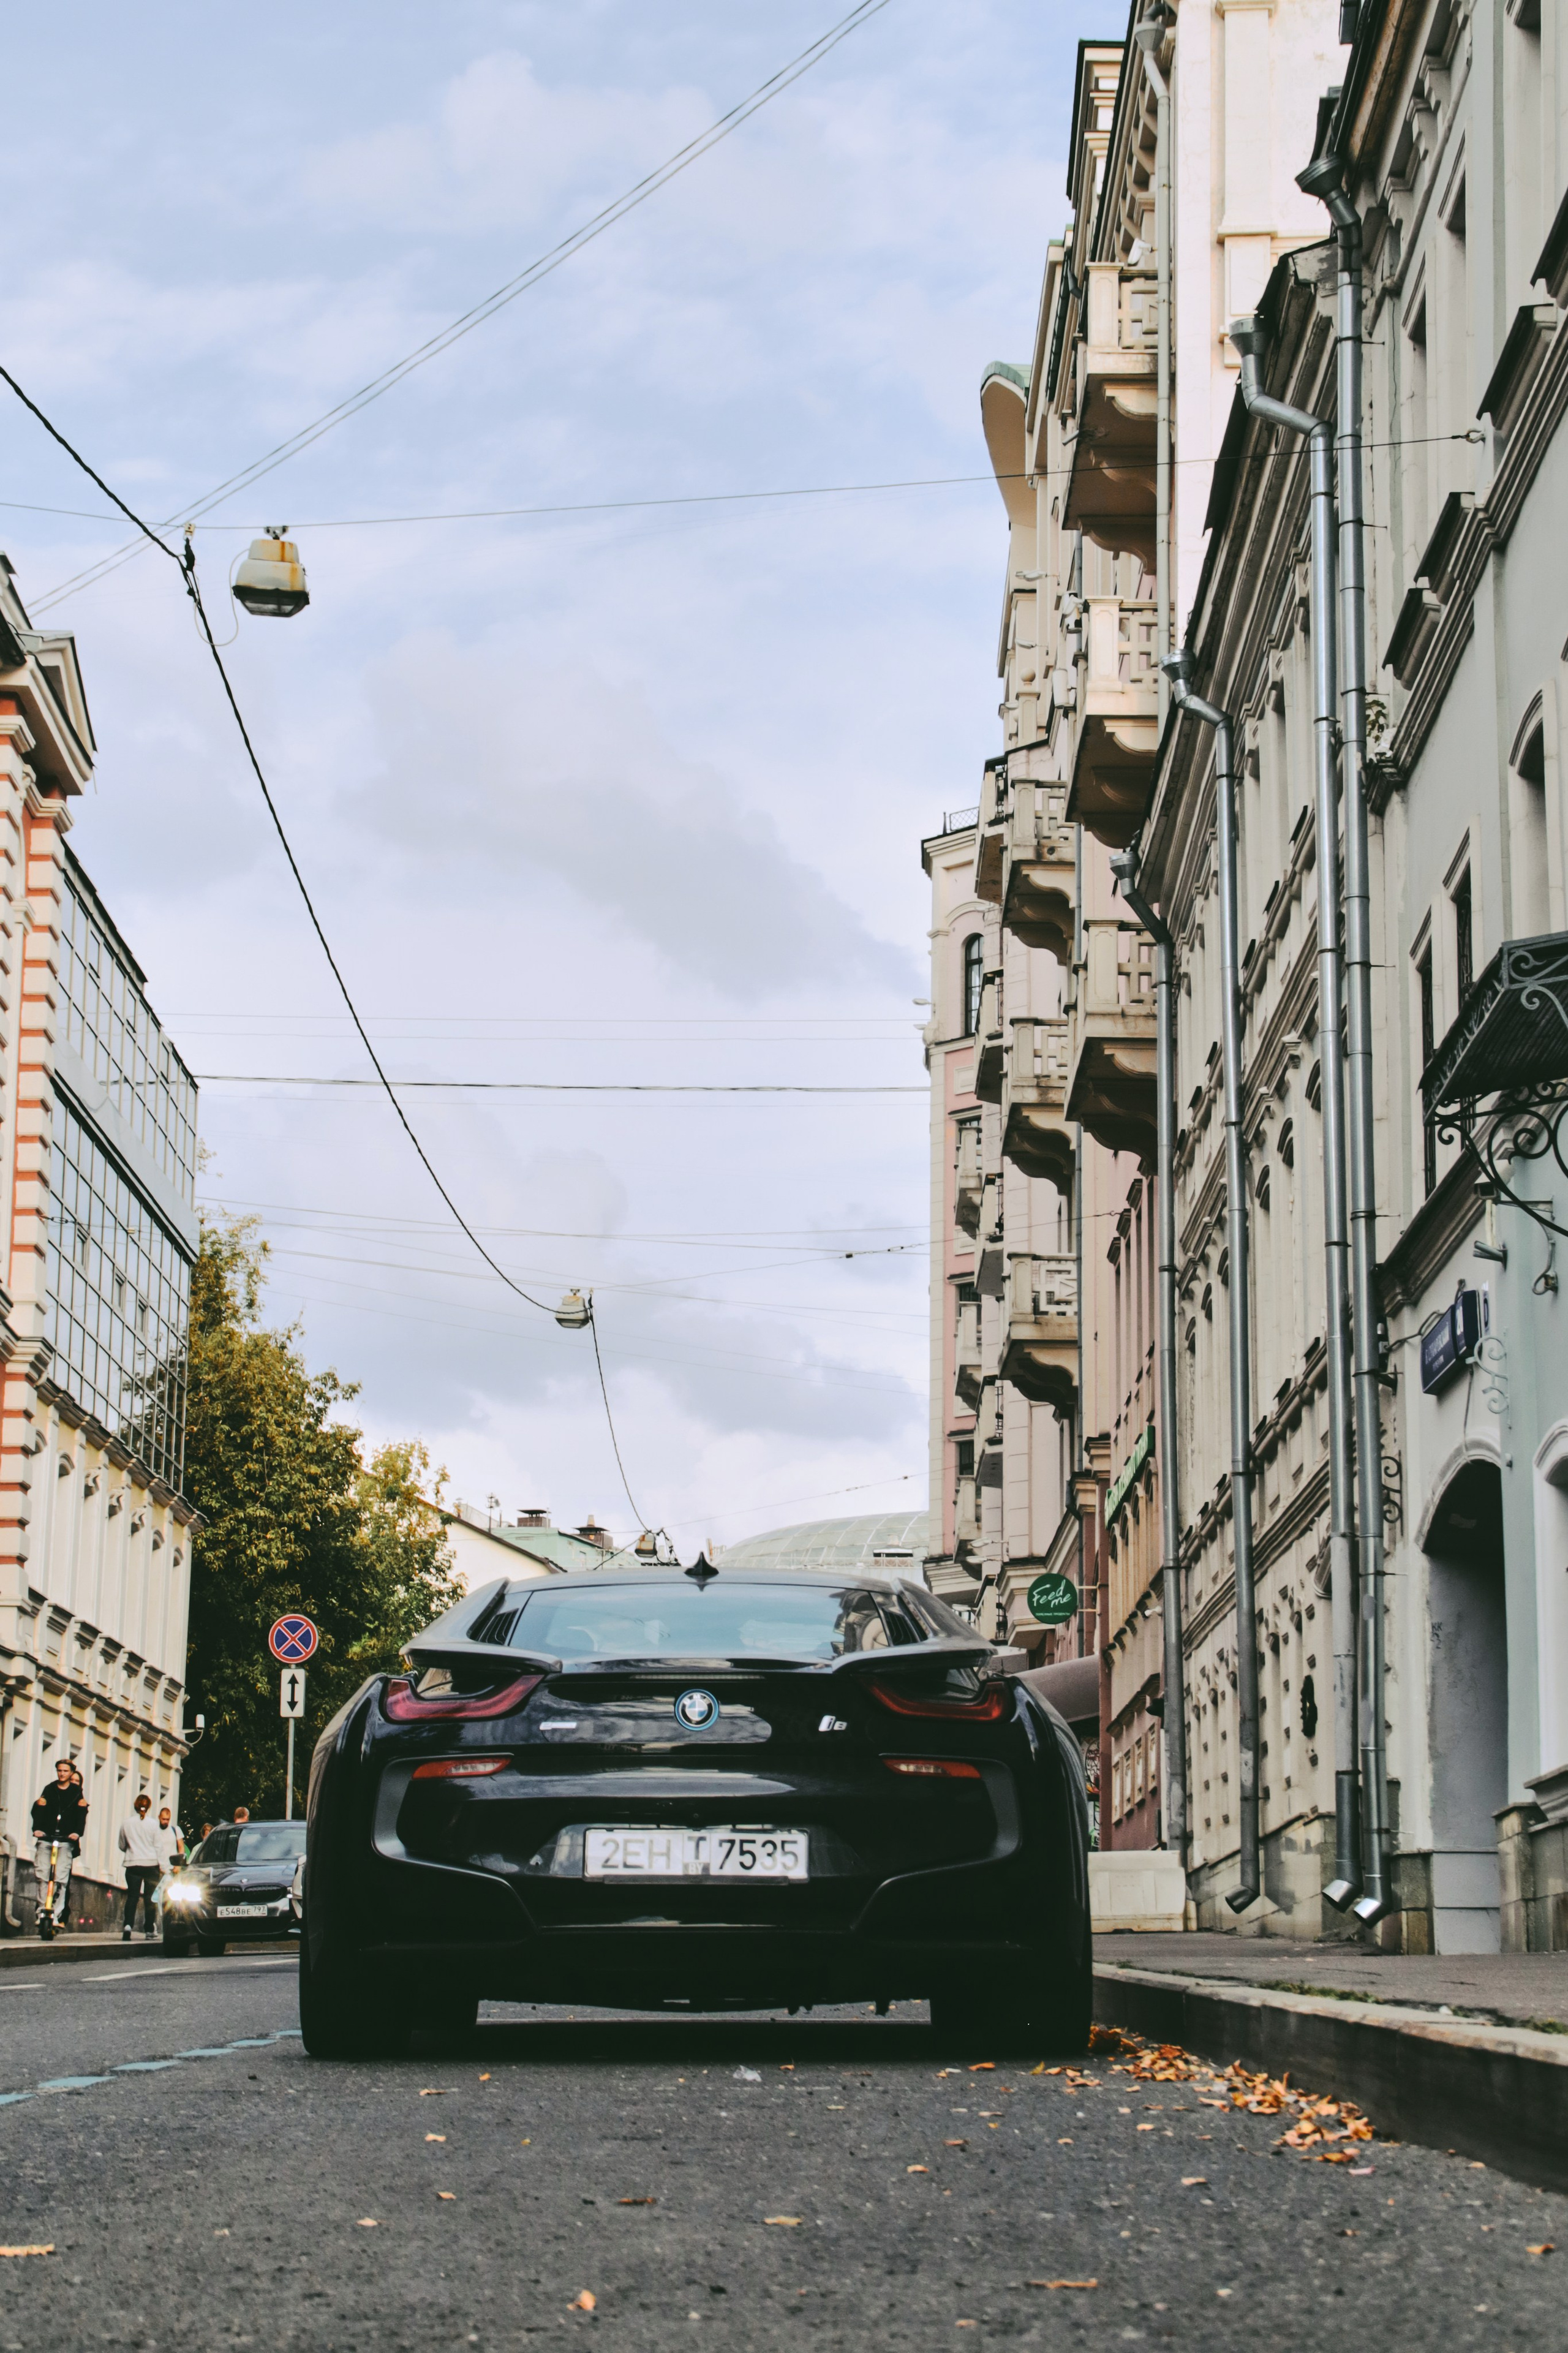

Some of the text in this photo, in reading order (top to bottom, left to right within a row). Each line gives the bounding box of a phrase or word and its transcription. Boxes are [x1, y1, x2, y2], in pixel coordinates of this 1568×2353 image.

[1032, 1579, 1066, 1606] Feed
[1050, 1593, 1072, 1608] me
[818, 1715, 848, 1732] i8
[718, 1838, 799, 1871] 7535
[688, 1862, 704, 1875] BY
